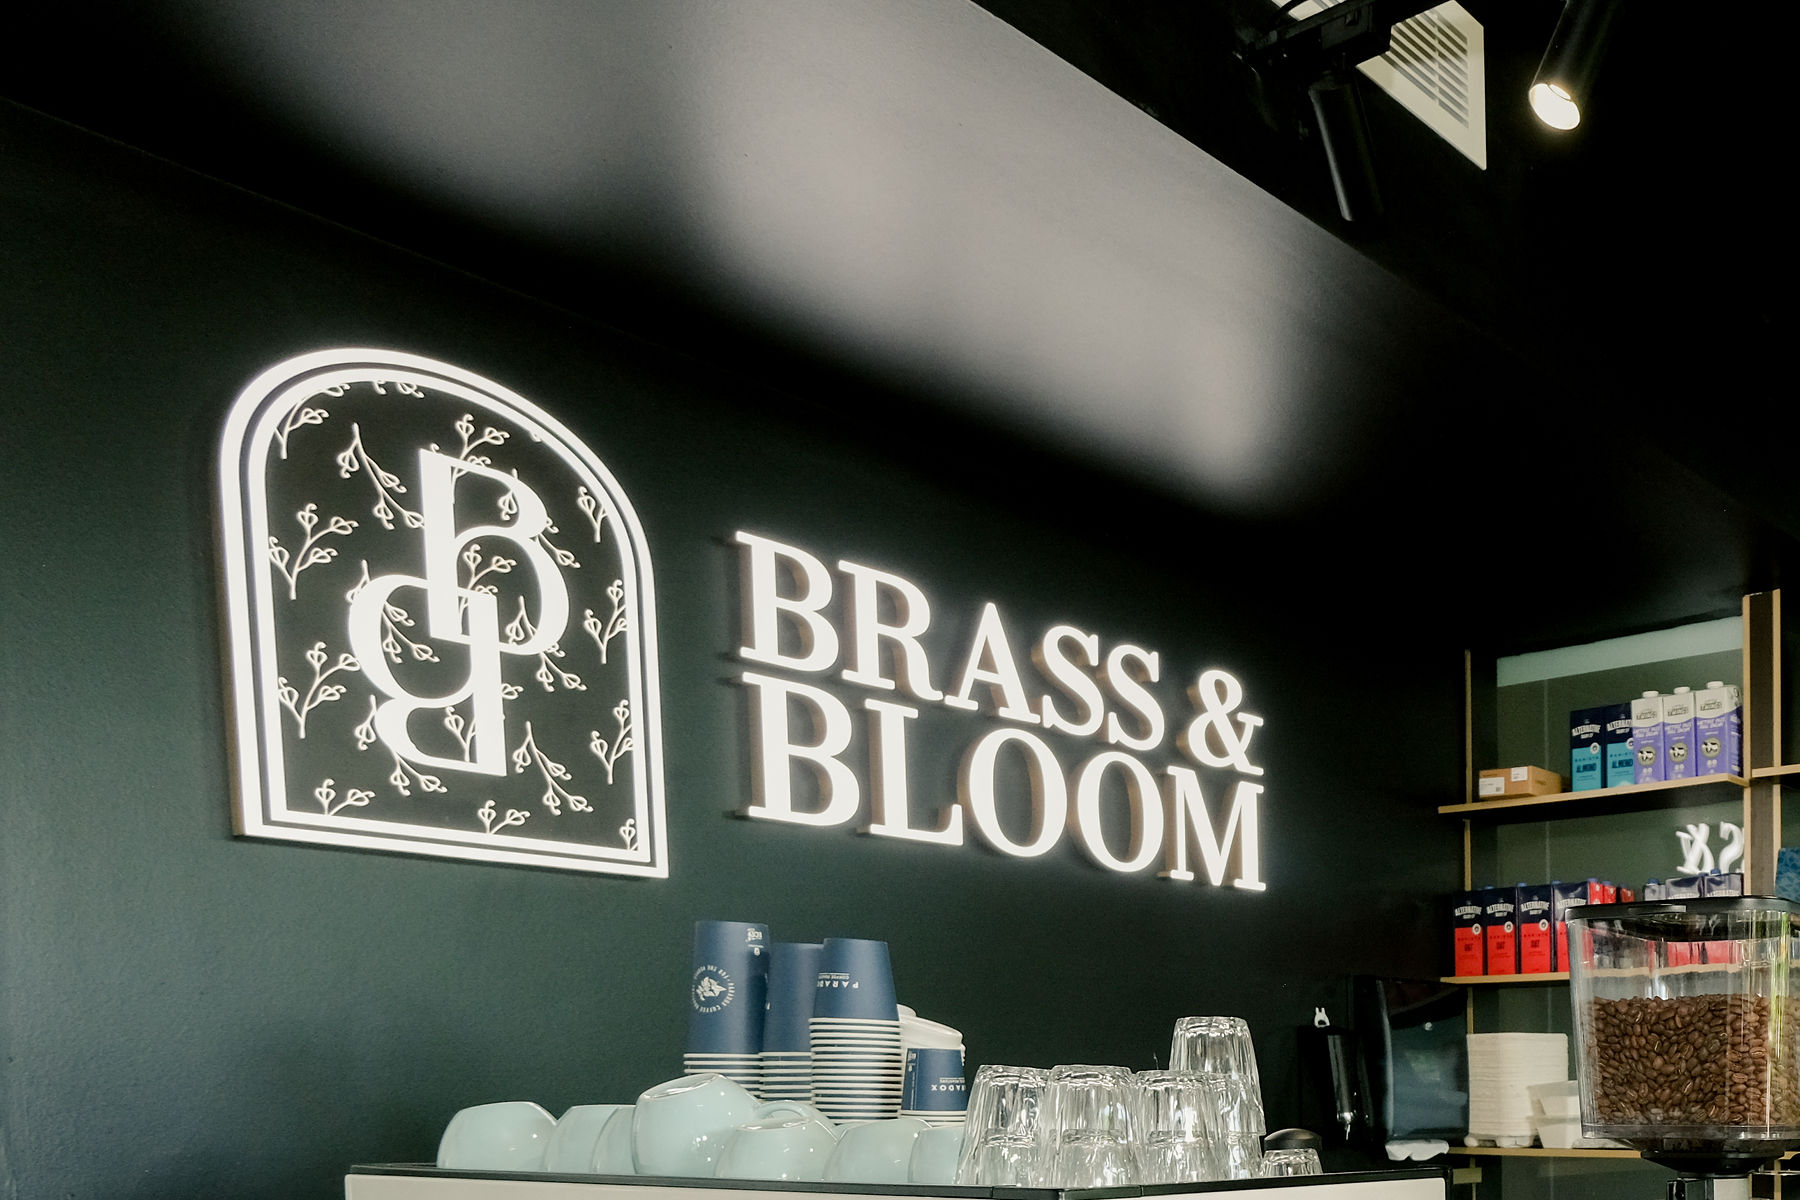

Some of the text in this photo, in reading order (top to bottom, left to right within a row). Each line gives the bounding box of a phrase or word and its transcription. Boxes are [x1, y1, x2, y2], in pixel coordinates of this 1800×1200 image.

[733, 530, 1264, 776] BRASS &
[740, 671, 1268, 892] BLOOM
